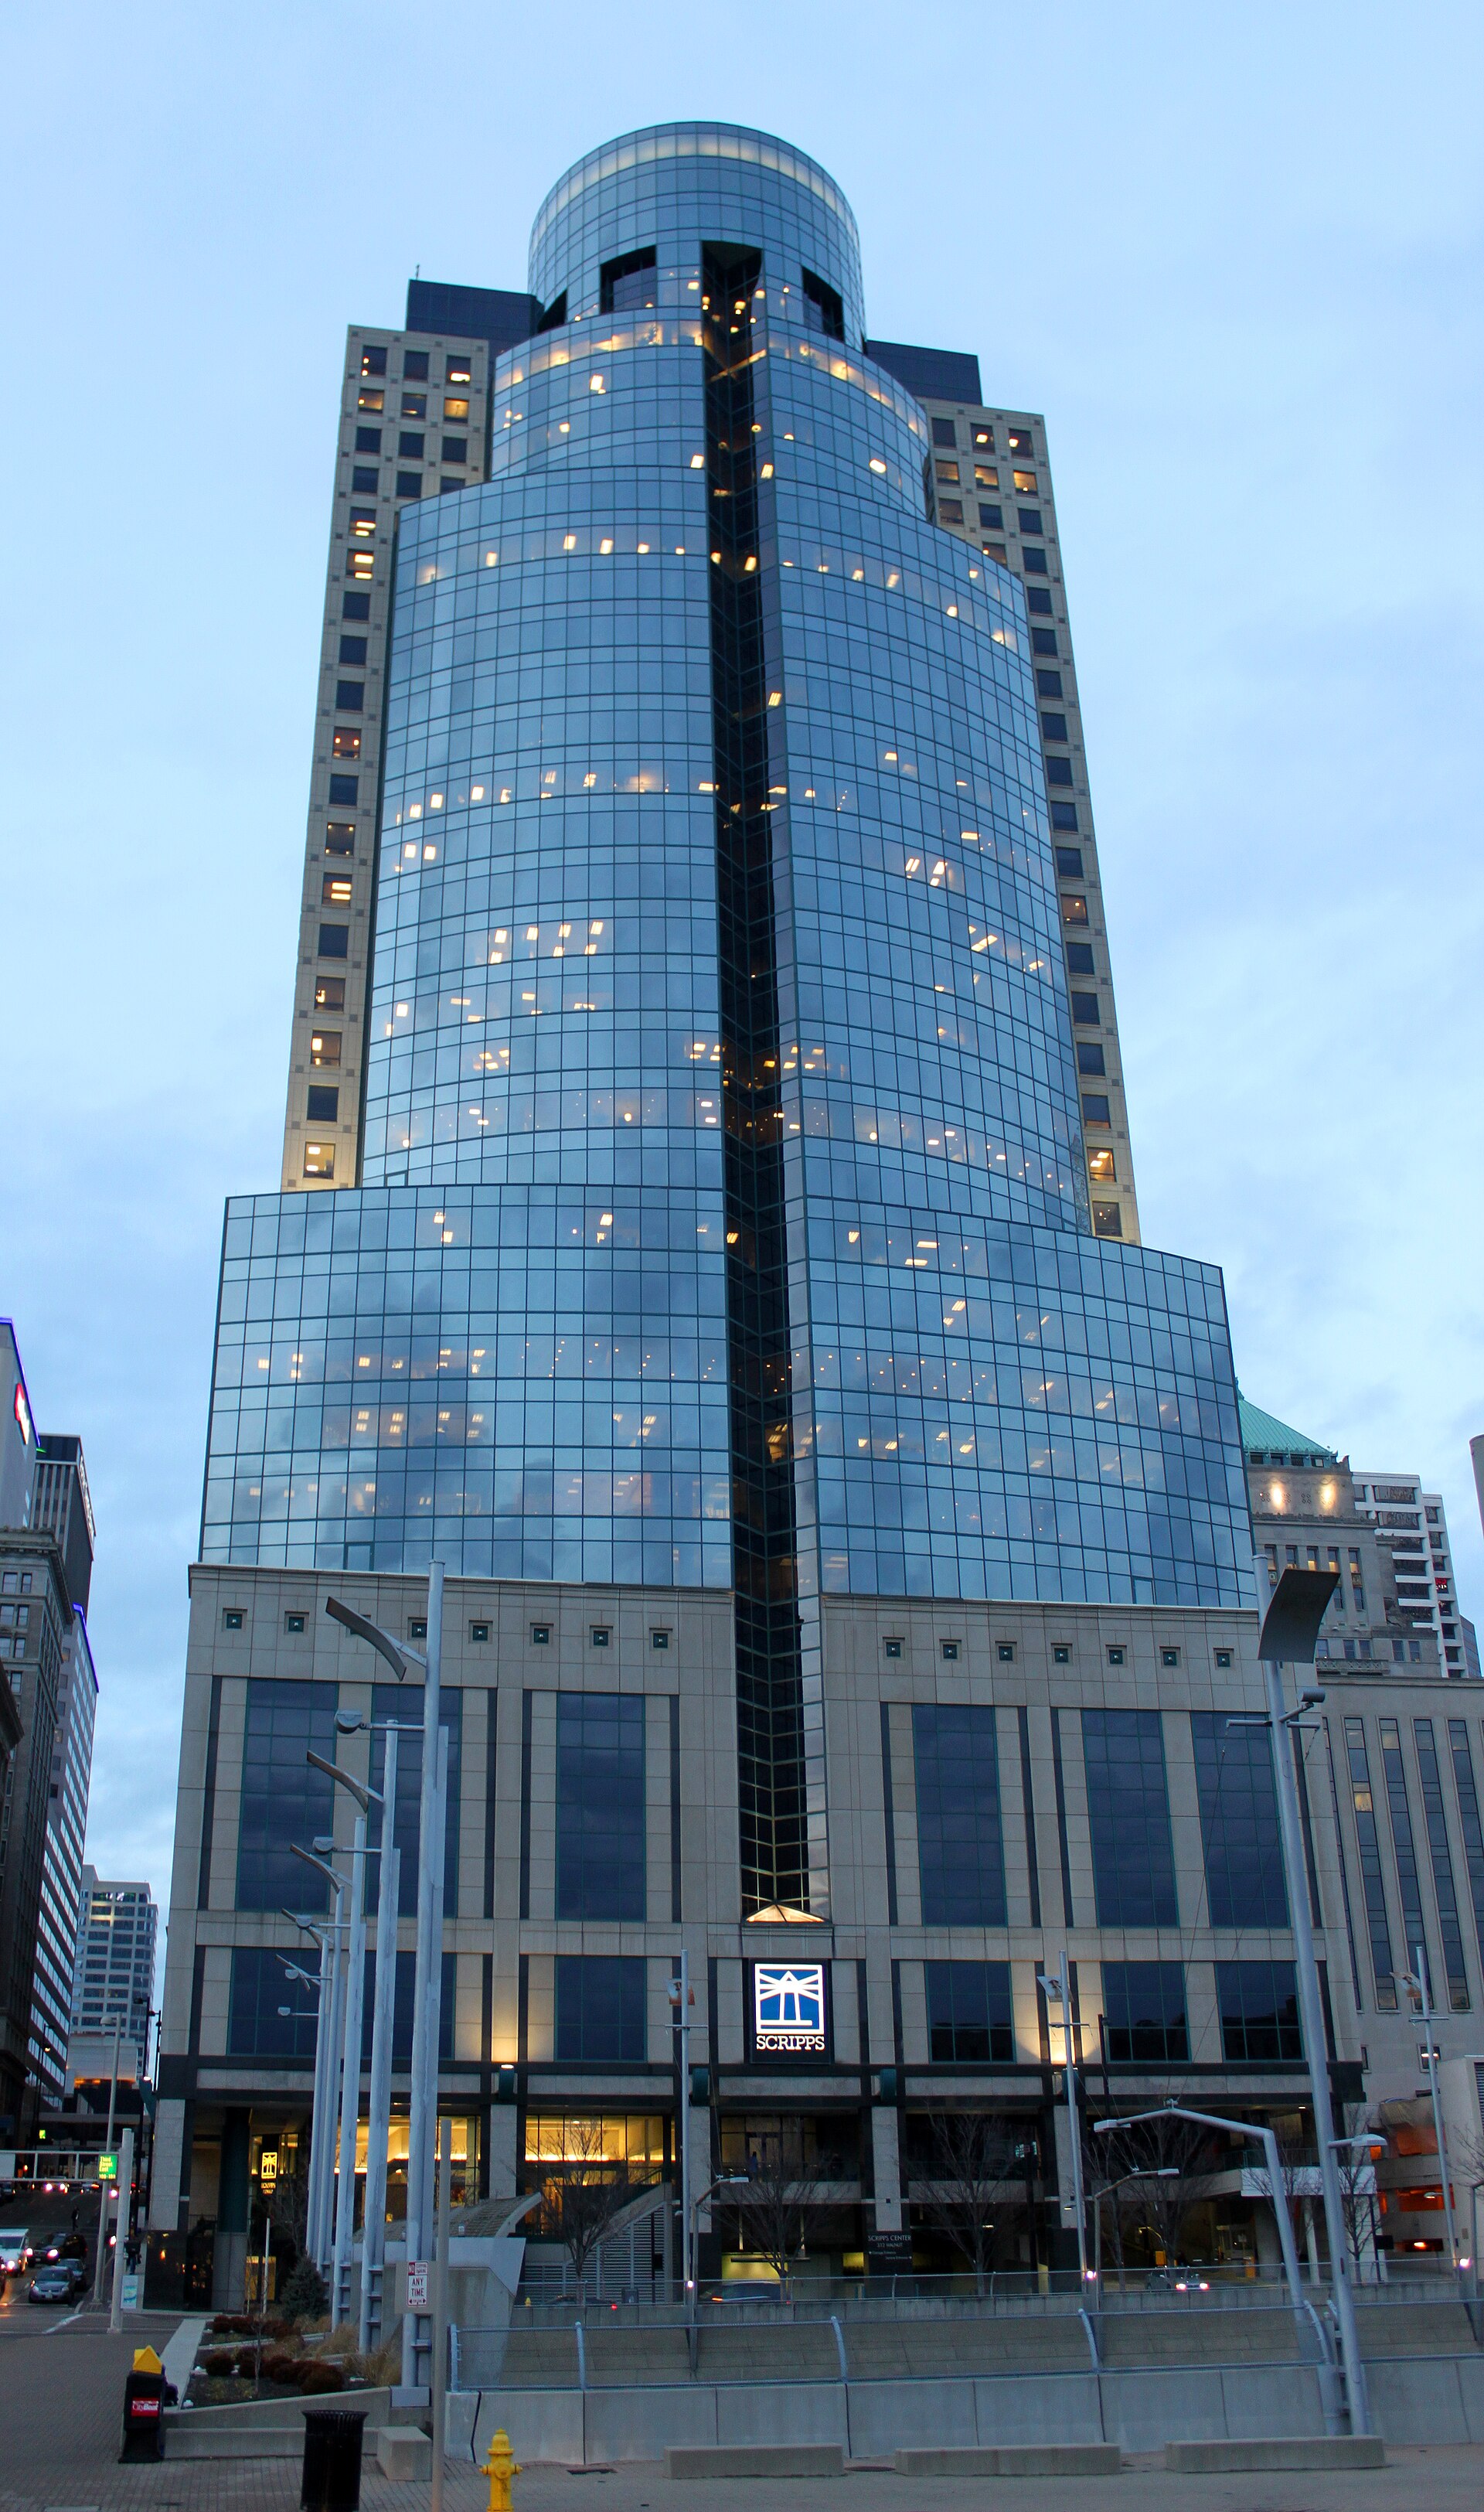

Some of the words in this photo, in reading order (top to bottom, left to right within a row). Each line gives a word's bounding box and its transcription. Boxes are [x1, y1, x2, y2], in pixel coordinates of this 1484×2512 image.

[756, 2035, 825, 2050] SCRIPPS
[412, 2277, 424, 2286] ANY
[411, 2288, 424, 2297] TIME
